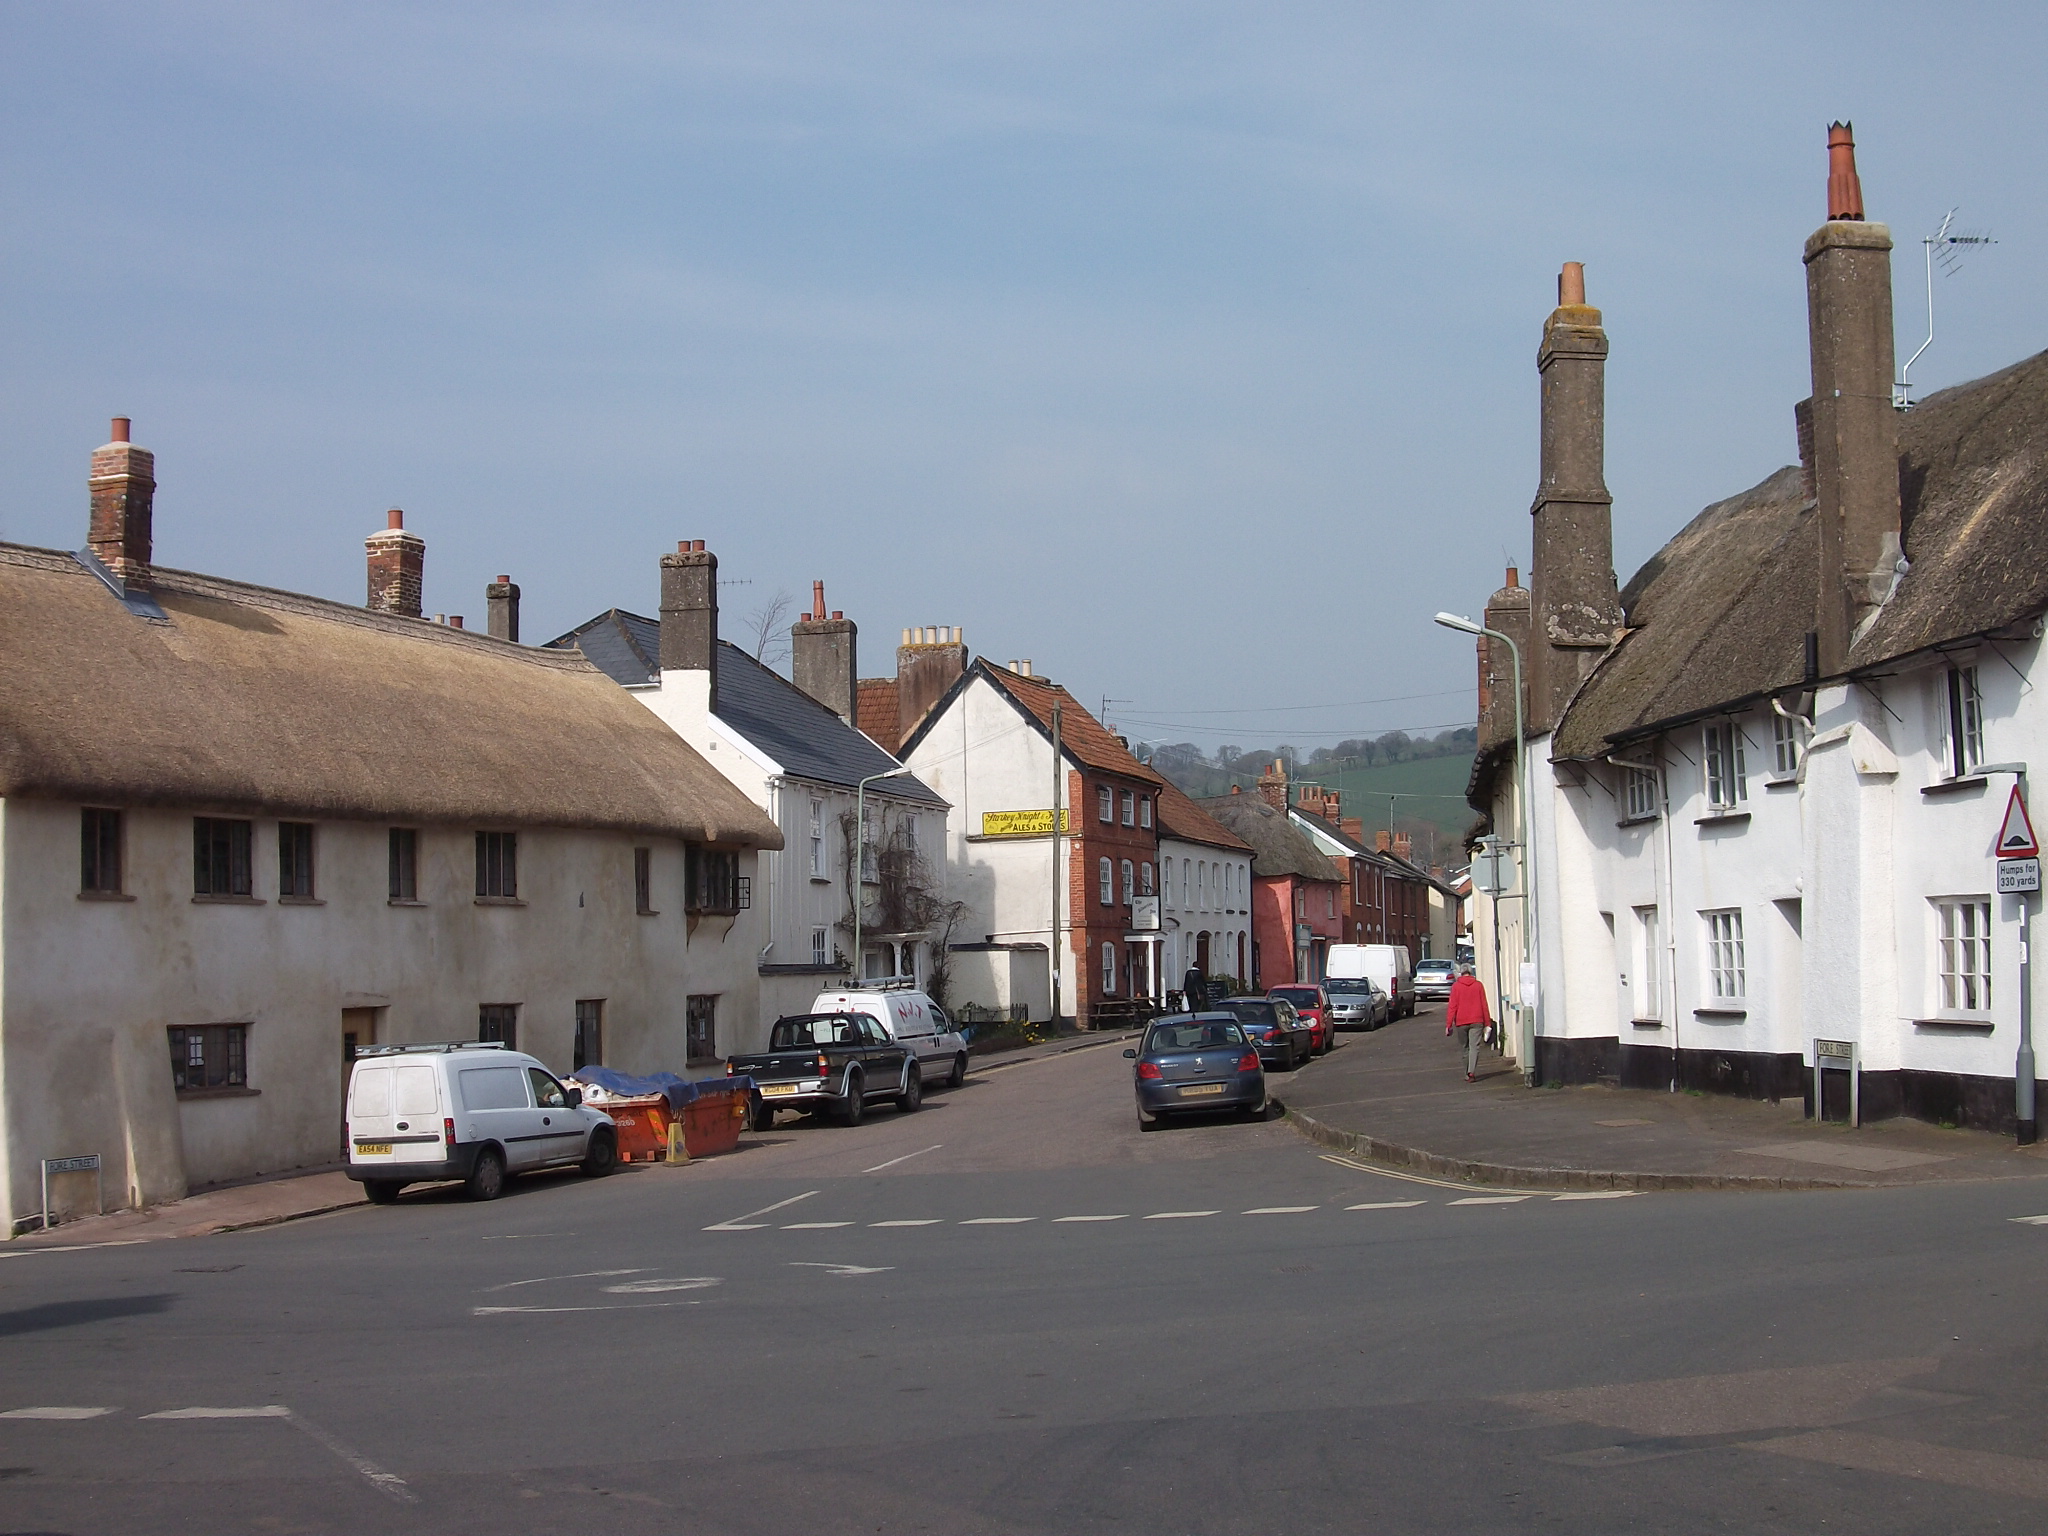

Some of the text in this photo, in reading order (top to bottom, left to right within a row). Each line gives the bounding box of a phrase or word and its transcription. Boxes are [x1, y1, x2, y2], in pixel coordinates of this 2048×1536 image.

[2000, 863, 2036, 875] Humps for
[2000, 876, 2036, 887] 330 yards
[1819, 1042, 1834, 1054] FORE
[359, 1144, 389, 1153] EA54 NFE
[49, 1158, 96, 1171] FORE STREET
